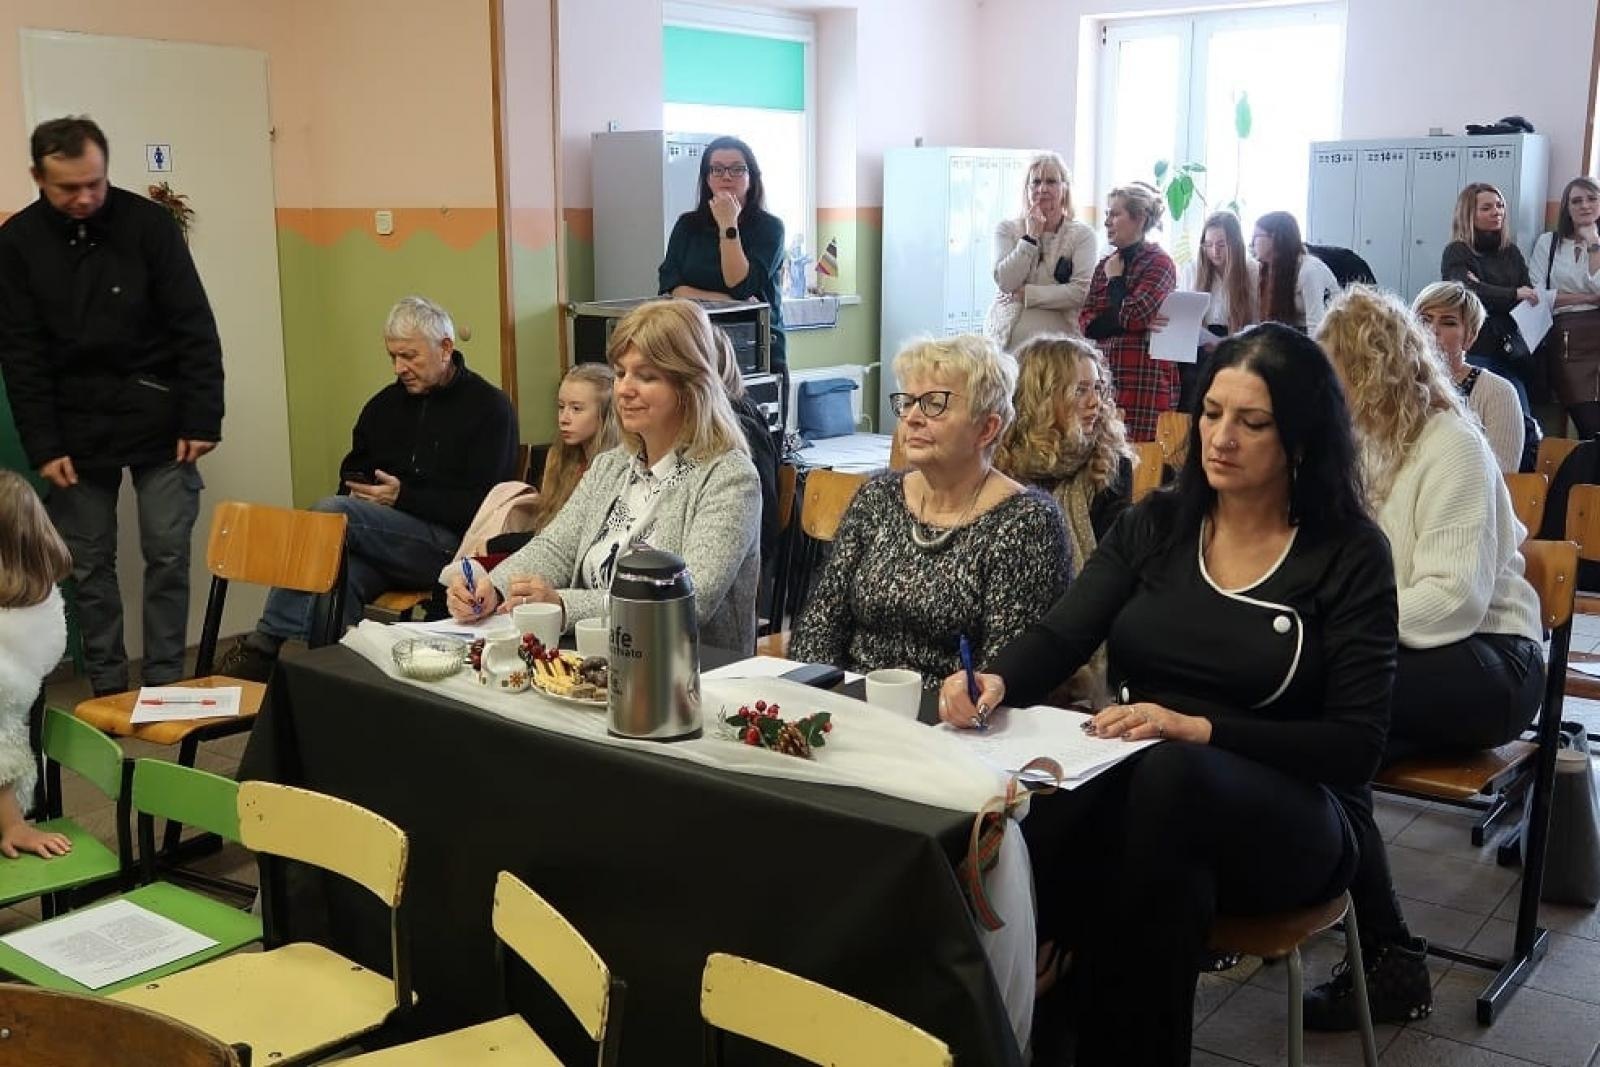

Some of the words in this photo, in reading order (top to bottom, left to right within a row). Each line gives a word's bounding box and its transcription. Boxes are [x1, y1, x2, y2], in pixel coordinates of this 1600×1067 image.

[1330, 153, 1341, 163] 13
[1380, 152, 1391, 162] 14
[1433, 151, 1443, 161] 15
[1486, 149, 1497, 160] 16
